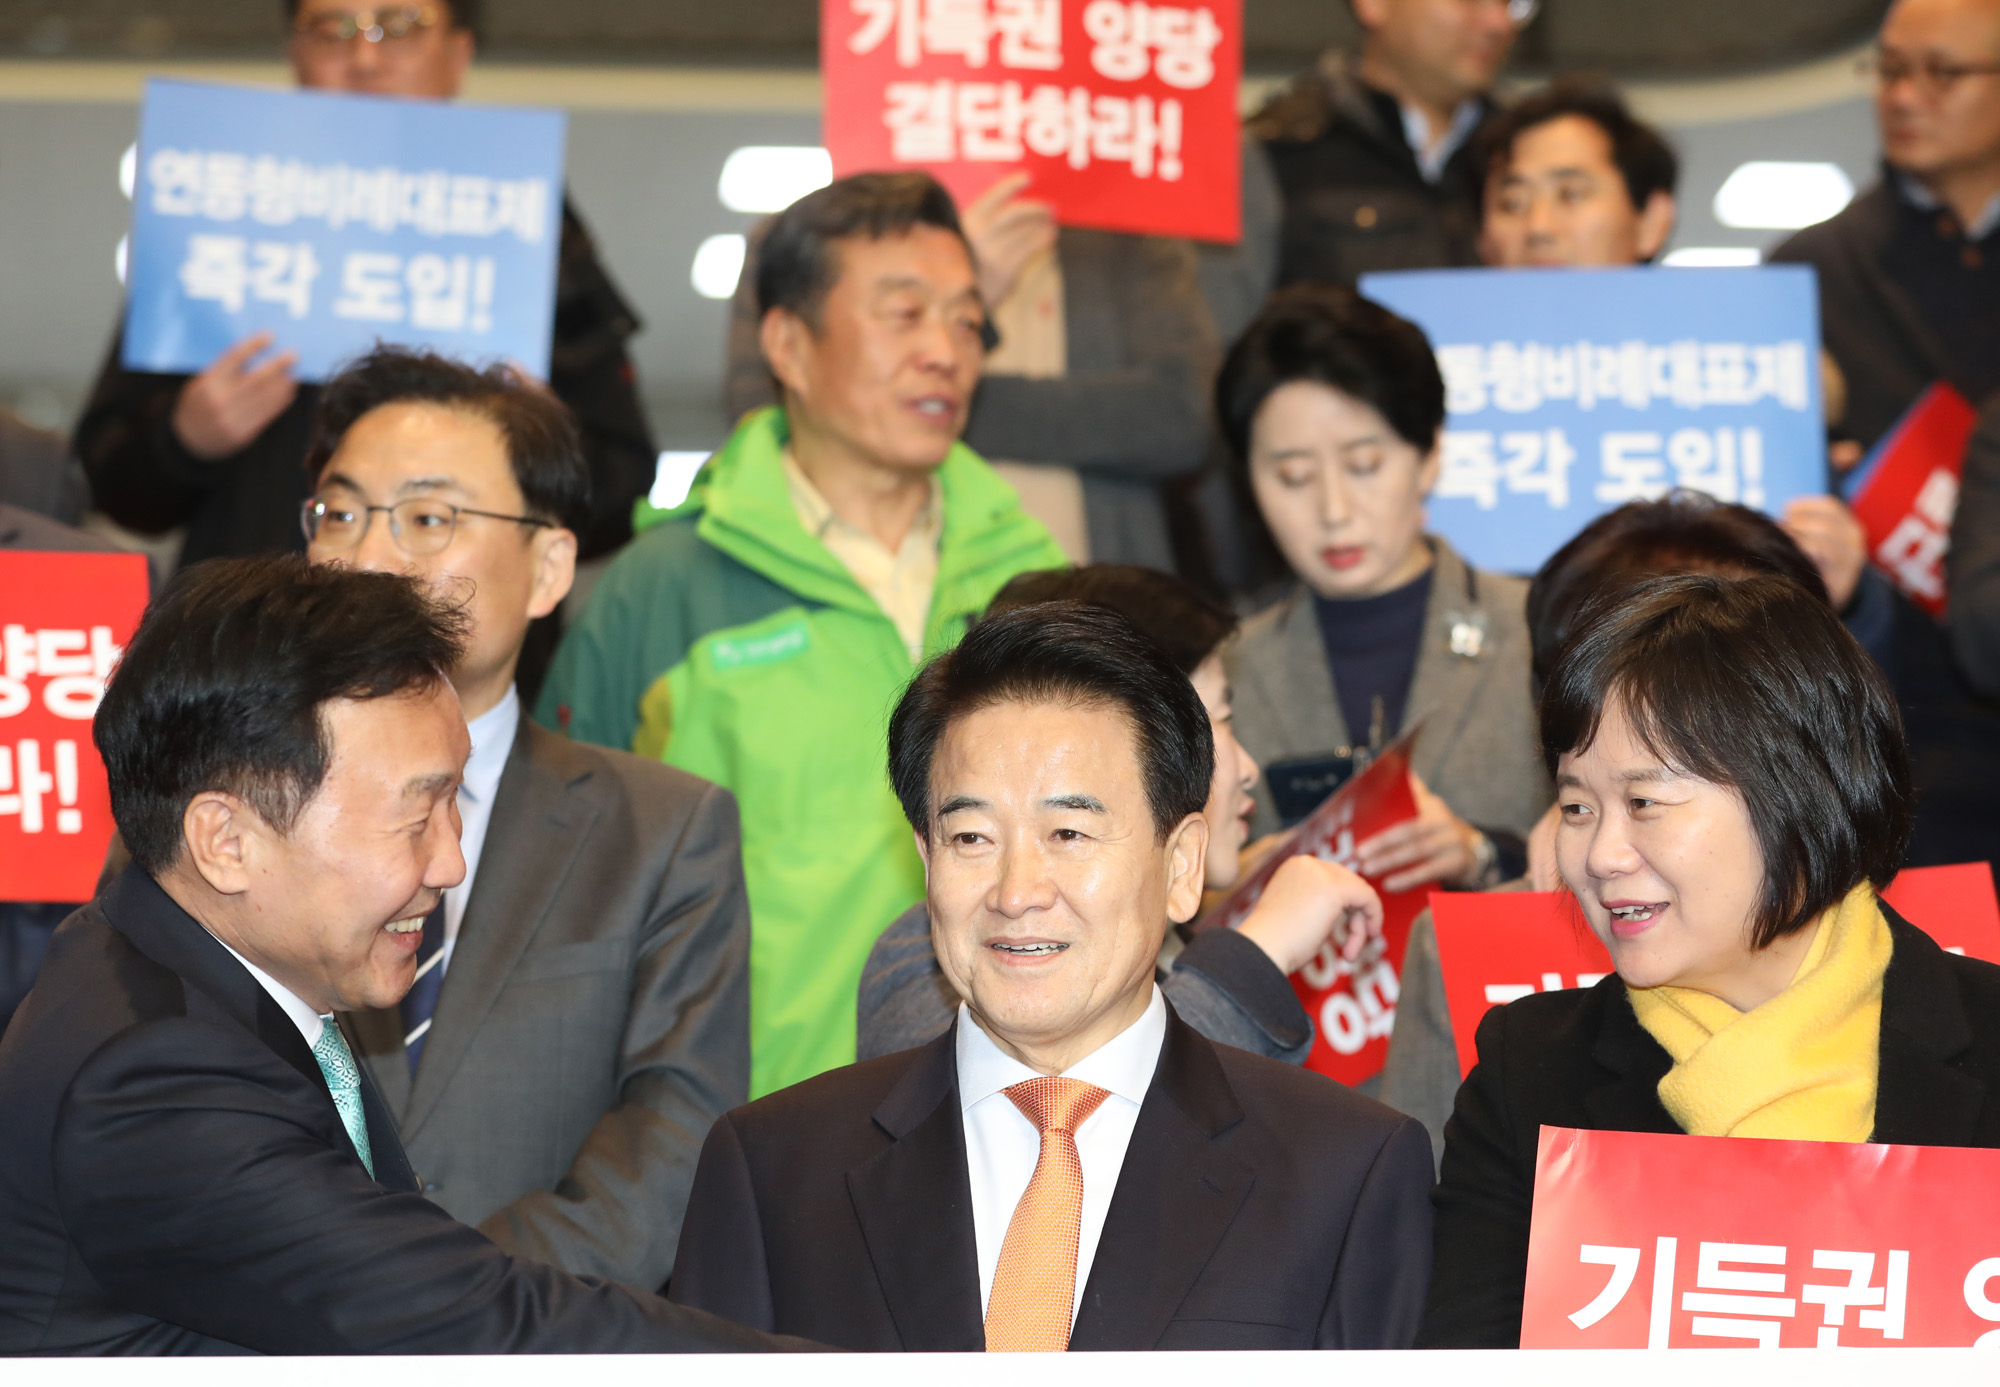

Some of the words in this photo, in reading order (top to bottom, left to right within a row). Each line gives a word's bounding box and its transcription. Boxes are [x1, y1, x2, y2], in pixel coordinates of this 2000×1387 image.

[848, 0, 1063, 70] 기득권
[1083, 0, 1222, 89] 양당
[883, 77, 1183, 181] 결단하라!
[148, 148, 548, 243] 연동형비례대표제
[179, 233, 319, 318] 즉각
[333, 251, 496, 332] 도입!
[1436, 340, 1807, 413] 동형비례대표제
[1436, 427, 1576, 509] 즉각
[1595, 426, 1765, 508] 도입!
[1567, 1236, 1910, 1348] 기득권
